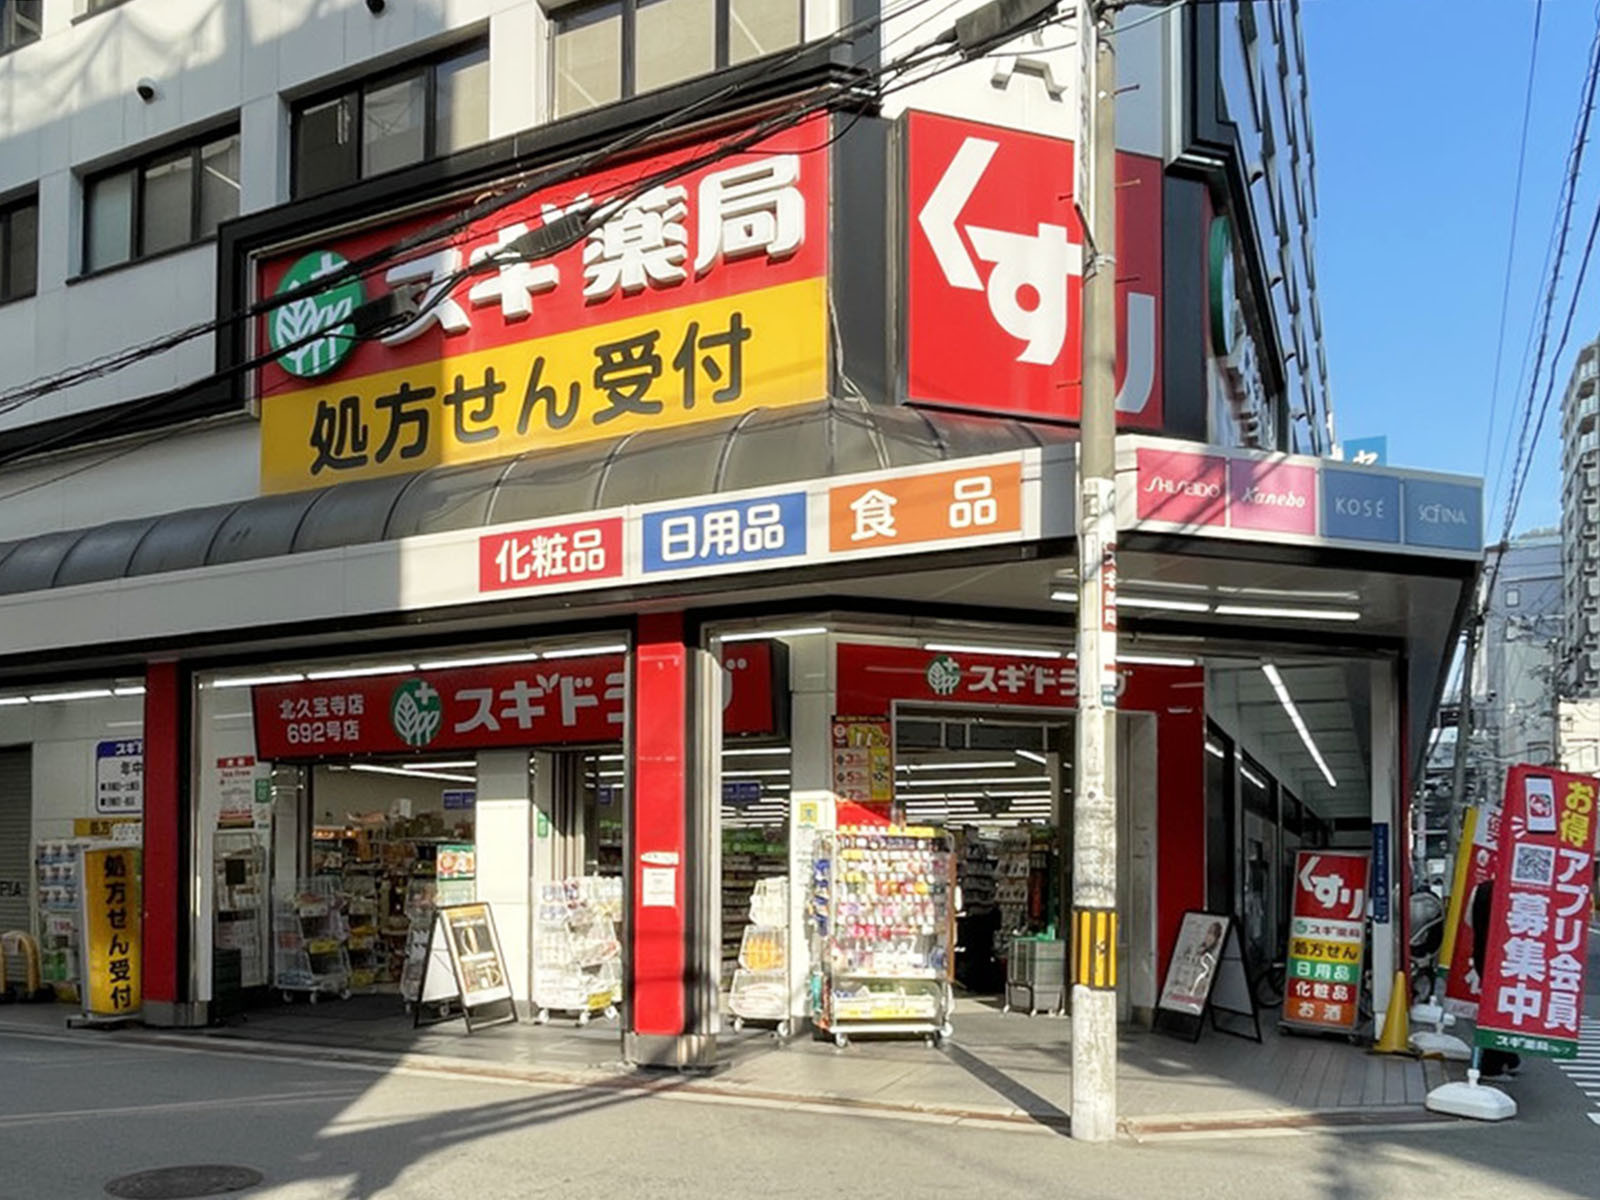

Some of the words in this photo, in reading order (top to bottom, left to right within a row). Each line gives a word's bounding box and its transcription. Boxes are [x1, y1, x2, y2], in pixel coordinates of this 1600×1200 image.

[378, 152, 807, 347] スギ薬局
[310, 311, 752, 476] 処方せん受付
[1240, 485, 1307, 508] Kanebo
[494, 526, 606, 584] 化粧品
[660, 502, 785, 563] 日用品
[278, 694, 365, 721] 北久宝寺店
[285, 721, 361, 746] 692号店
[1299, 855, 1364, 919] くすり
[104, 855, 132, 1009] 処方せん受付
[1496, 892, 1551, 1026] 募集中
[1295, 982, 1349, 1001] 化粧品
[1296, 963, 1350, 982] 日用品
